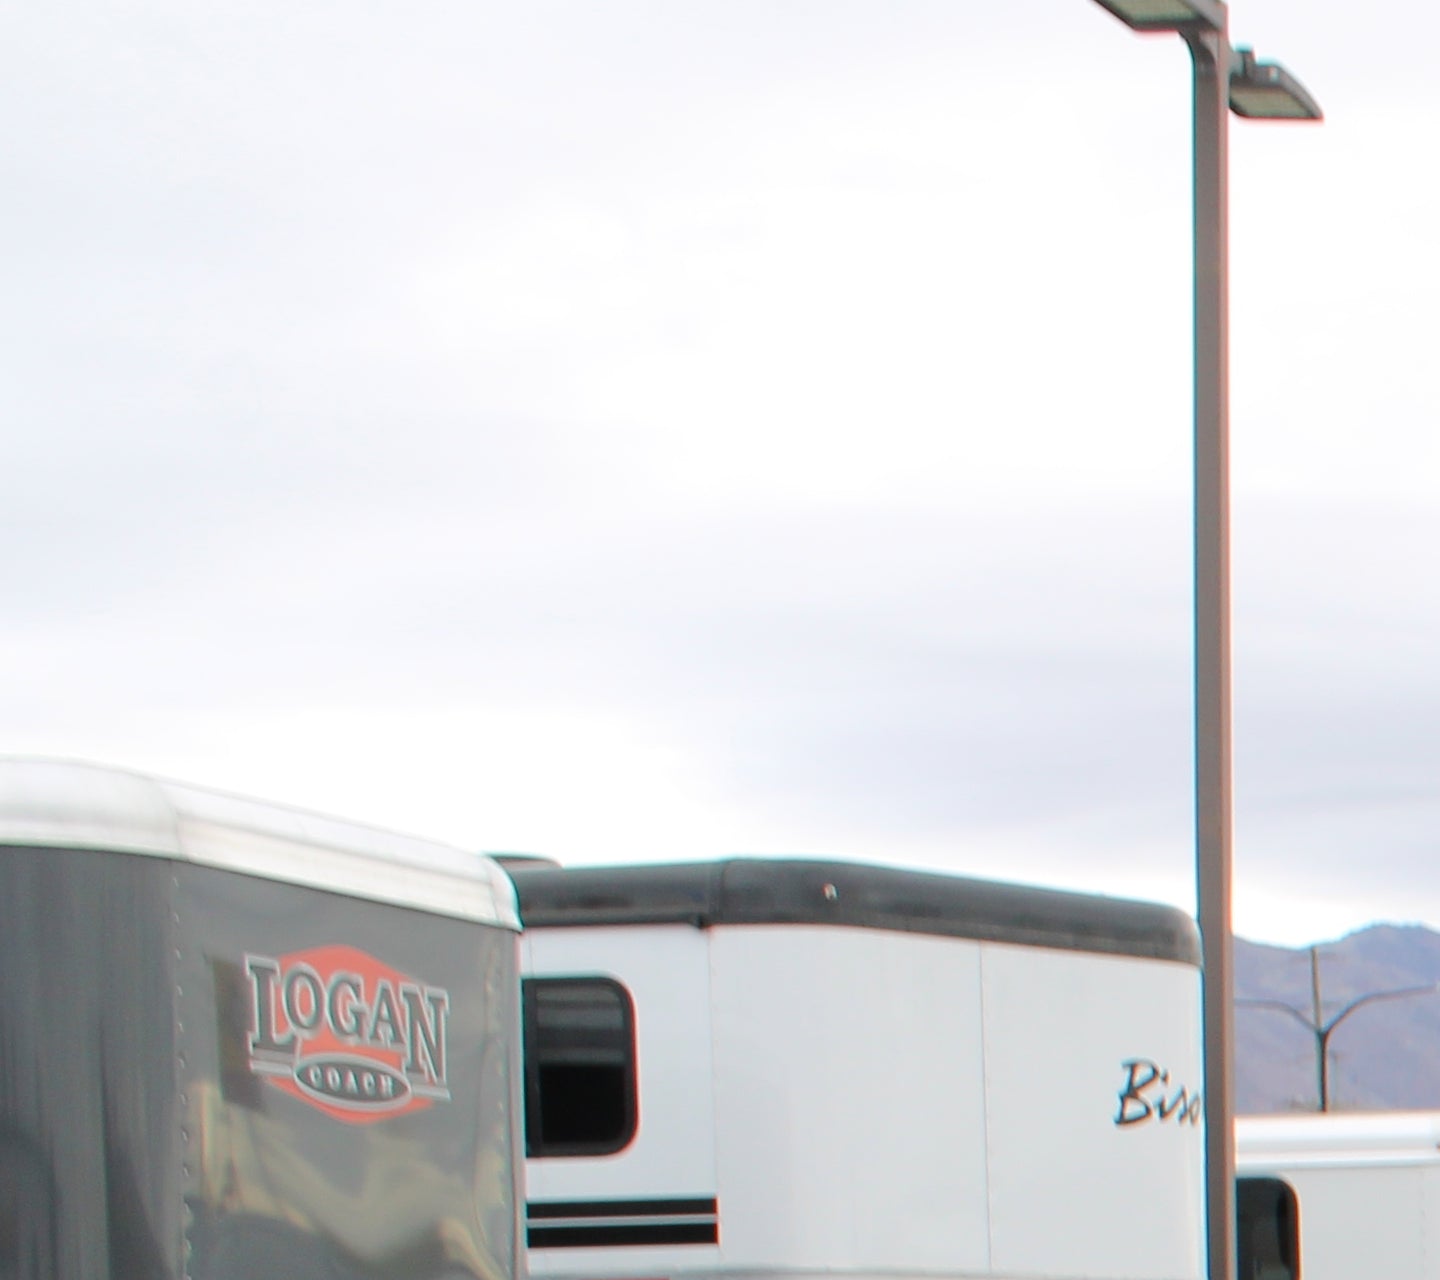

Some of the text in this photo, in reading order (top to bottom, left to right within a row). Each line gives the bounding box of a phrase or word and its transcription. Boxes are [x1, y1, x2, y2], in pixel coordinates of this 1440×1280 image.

[244, 952, 452, 1091] LOGAN
[308, 1066, 395, 1098] COACH
[1113, 1057, 1202, 1128] Biso
